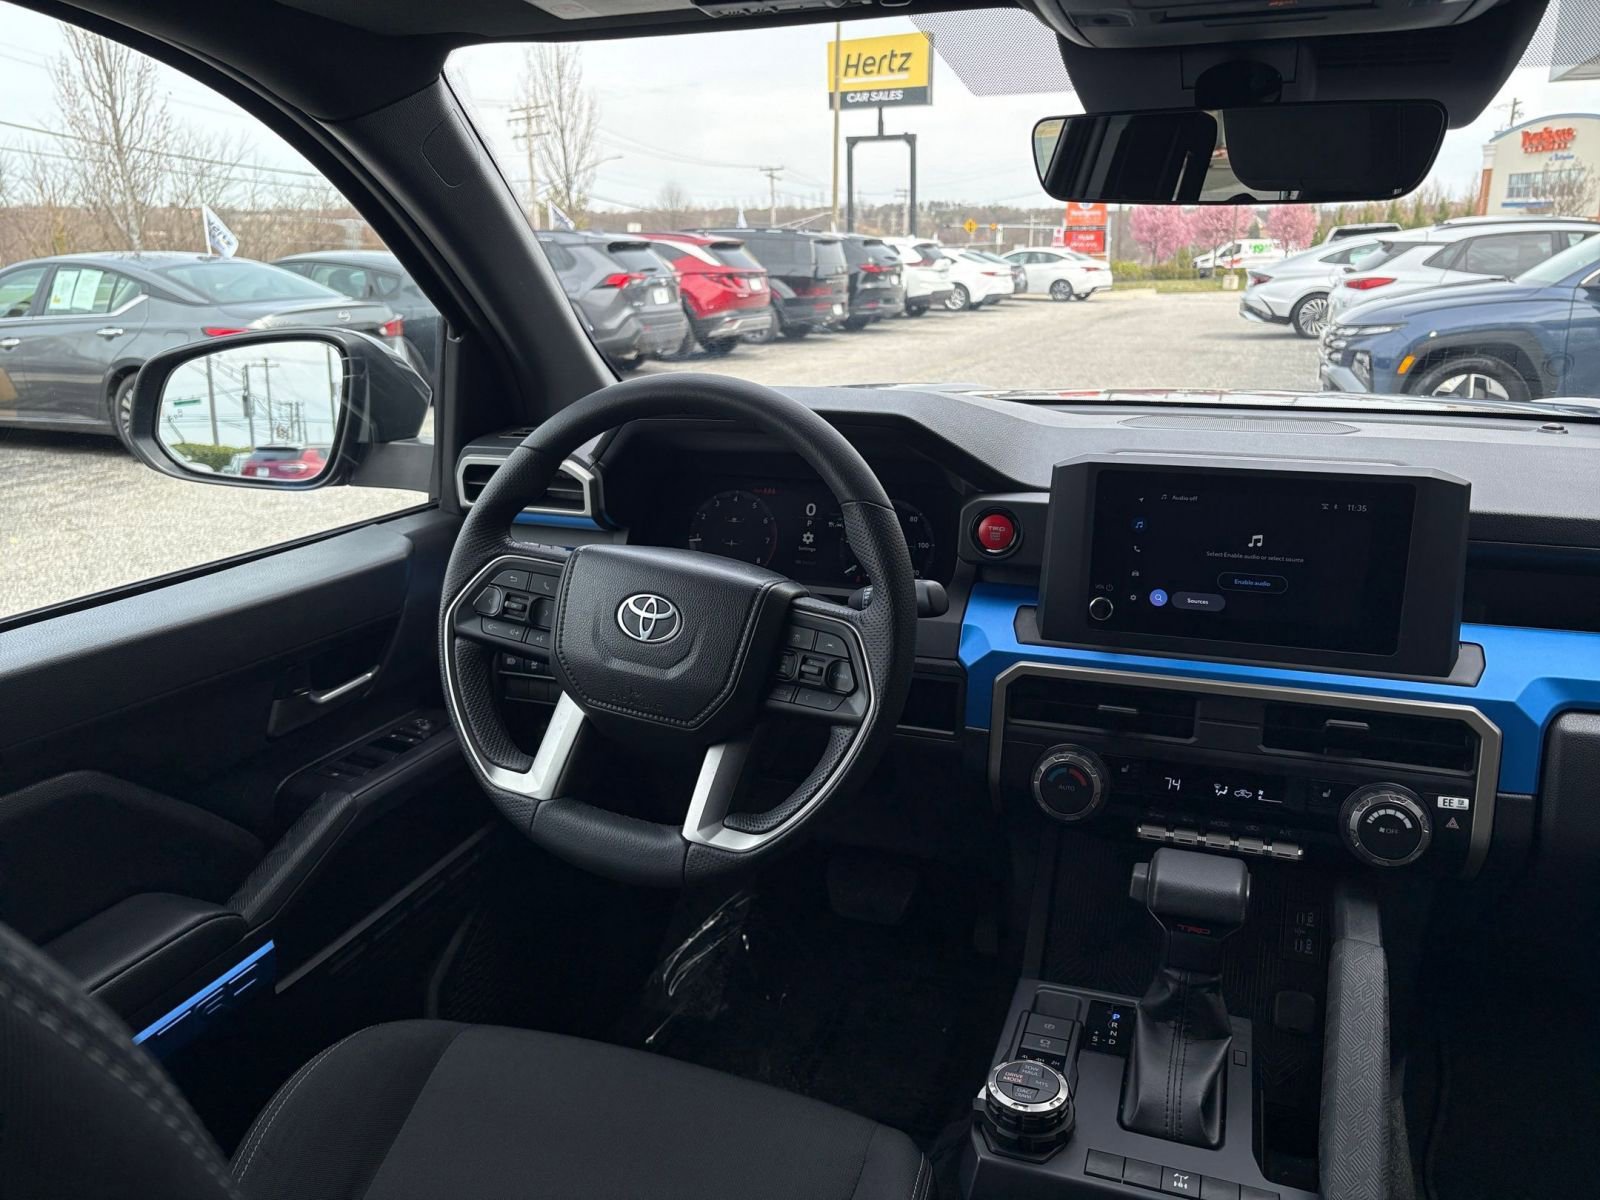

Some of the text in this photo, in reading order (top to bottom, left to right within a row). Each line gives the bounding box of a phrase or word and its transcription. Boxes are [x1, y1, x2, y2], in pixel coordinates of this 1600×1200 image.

[843, 49, 912, 77] Hertz
[847, 90, 904, 103] CAR SALES
[806, 503, 817, 516] 0
[1347, 504, 1368, 512] 11:35
[1234, 578, 1254, 586] Enable
[1165, 777, 1181, 791] 74
[1442, 798, 1454, 807] EE
[1004, 1071, 1023, 1079] DRIVE
